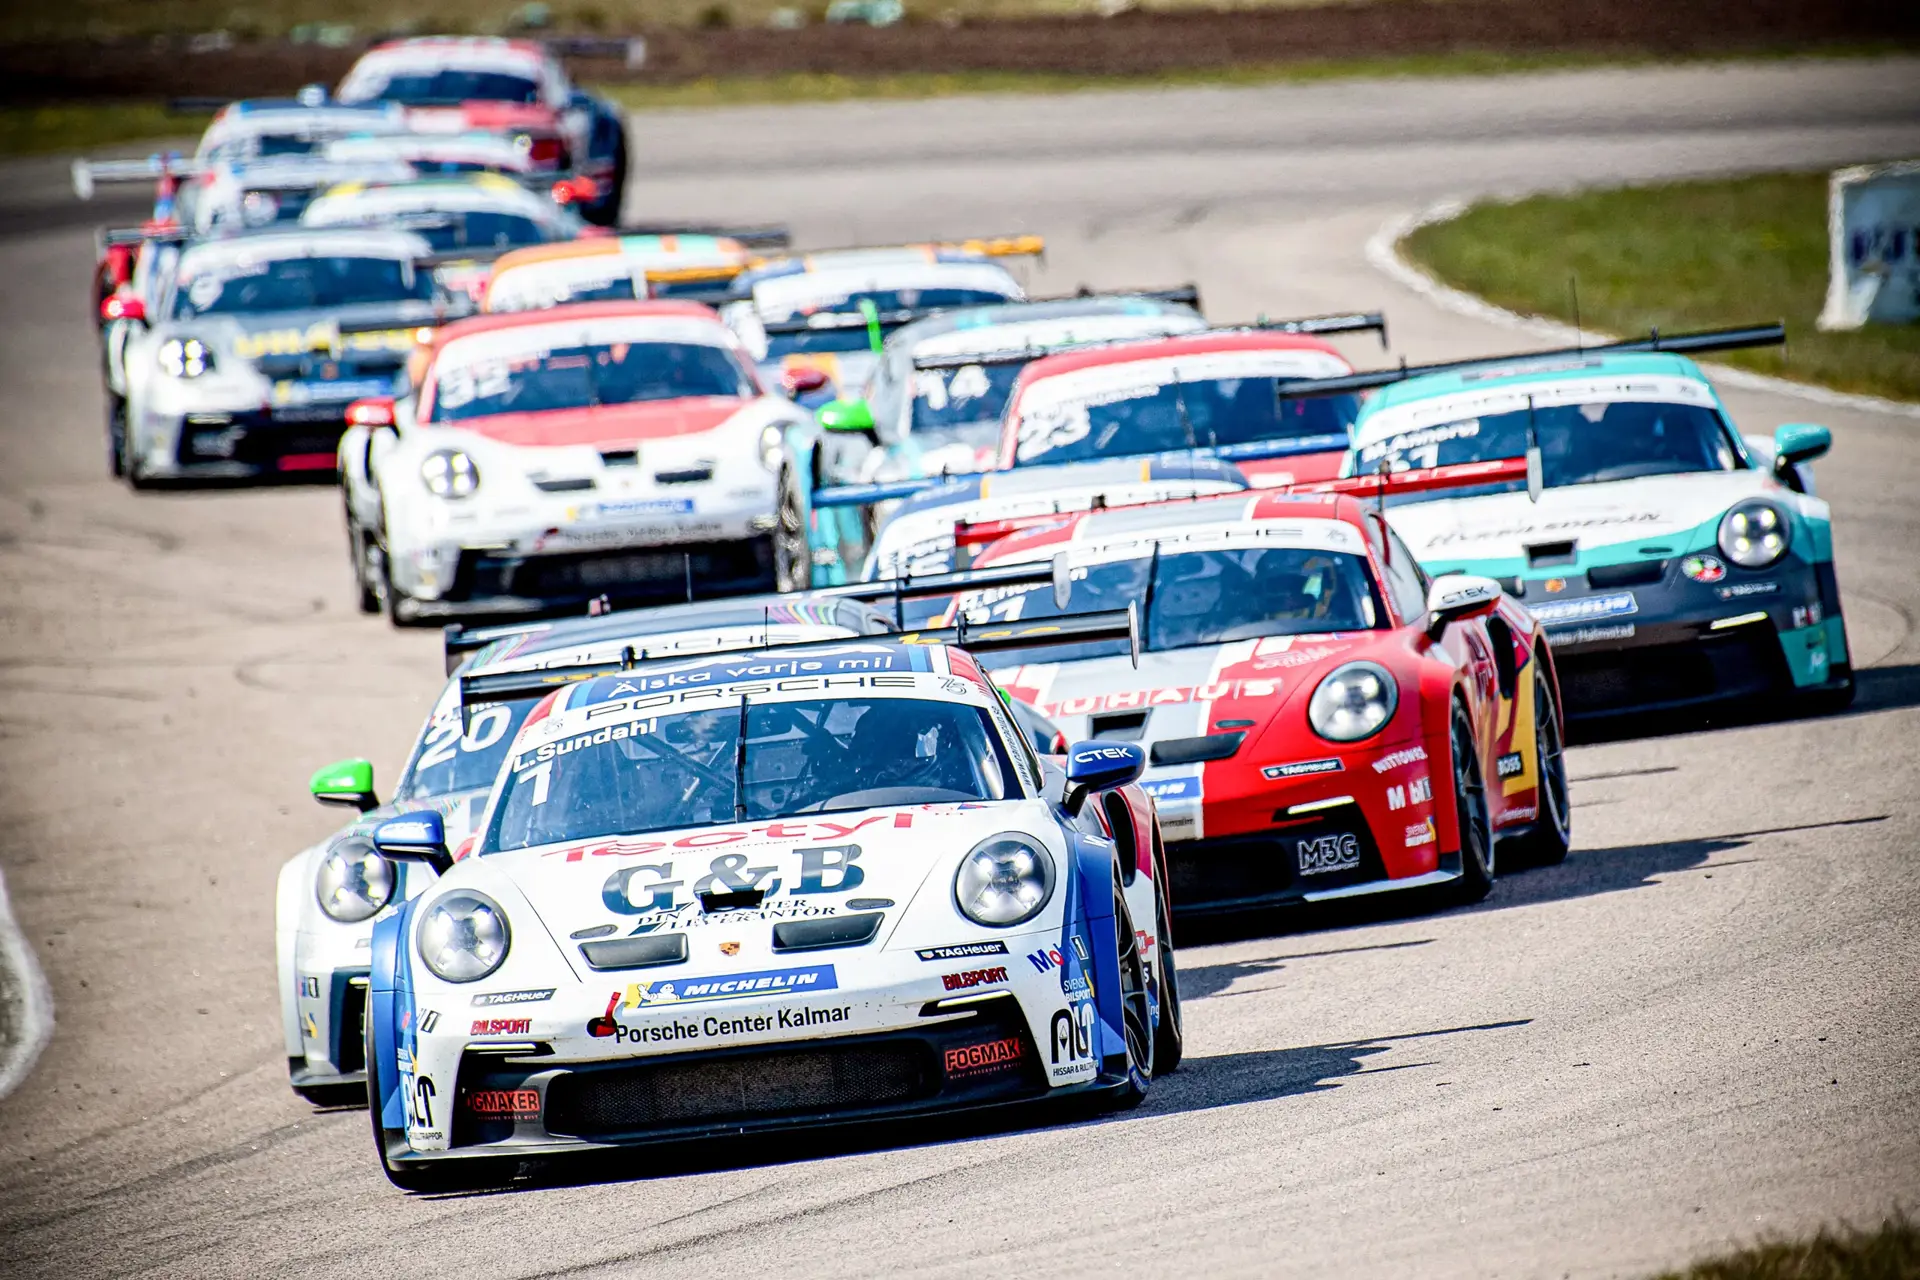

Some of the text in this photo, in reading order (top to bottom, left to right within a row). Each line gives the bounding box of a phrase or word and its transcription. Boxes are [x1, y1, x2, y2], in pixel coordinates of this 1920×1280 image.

[1441, 585, 1490, 605] CTEK
[607, 670, 712, 699] Älska
[726, 660, 824, 678] varje
[838, 655, 893, 670] mil
[586, 675, 916, 721] PORSCHE
[415, 705, 512, 772] 20
[512, 717, 658, 774] L.Sundahl
[1074, 747, 1134, 764] CTEK
[518, 762, 554, 807] 1
[1296, 833, 1361, 870] M3G
[602, 844, 865, 916] G&B
[935, 943, 1002, 958] TAGHeuer
[683, 973, 819, 996] MICHELIN
[941, 966, 1010, 991] BILSPORT
[488, 991, 551, 1004] TAGHeuer
[470, 1017, 533, 1036] BILSPORT
[615, 1005, 852, 1044] Porsche Center Kalmar
[945, 1036, 1024, 1071] FOGMAK
[466, 1091, 541, 1111] GMAKER
